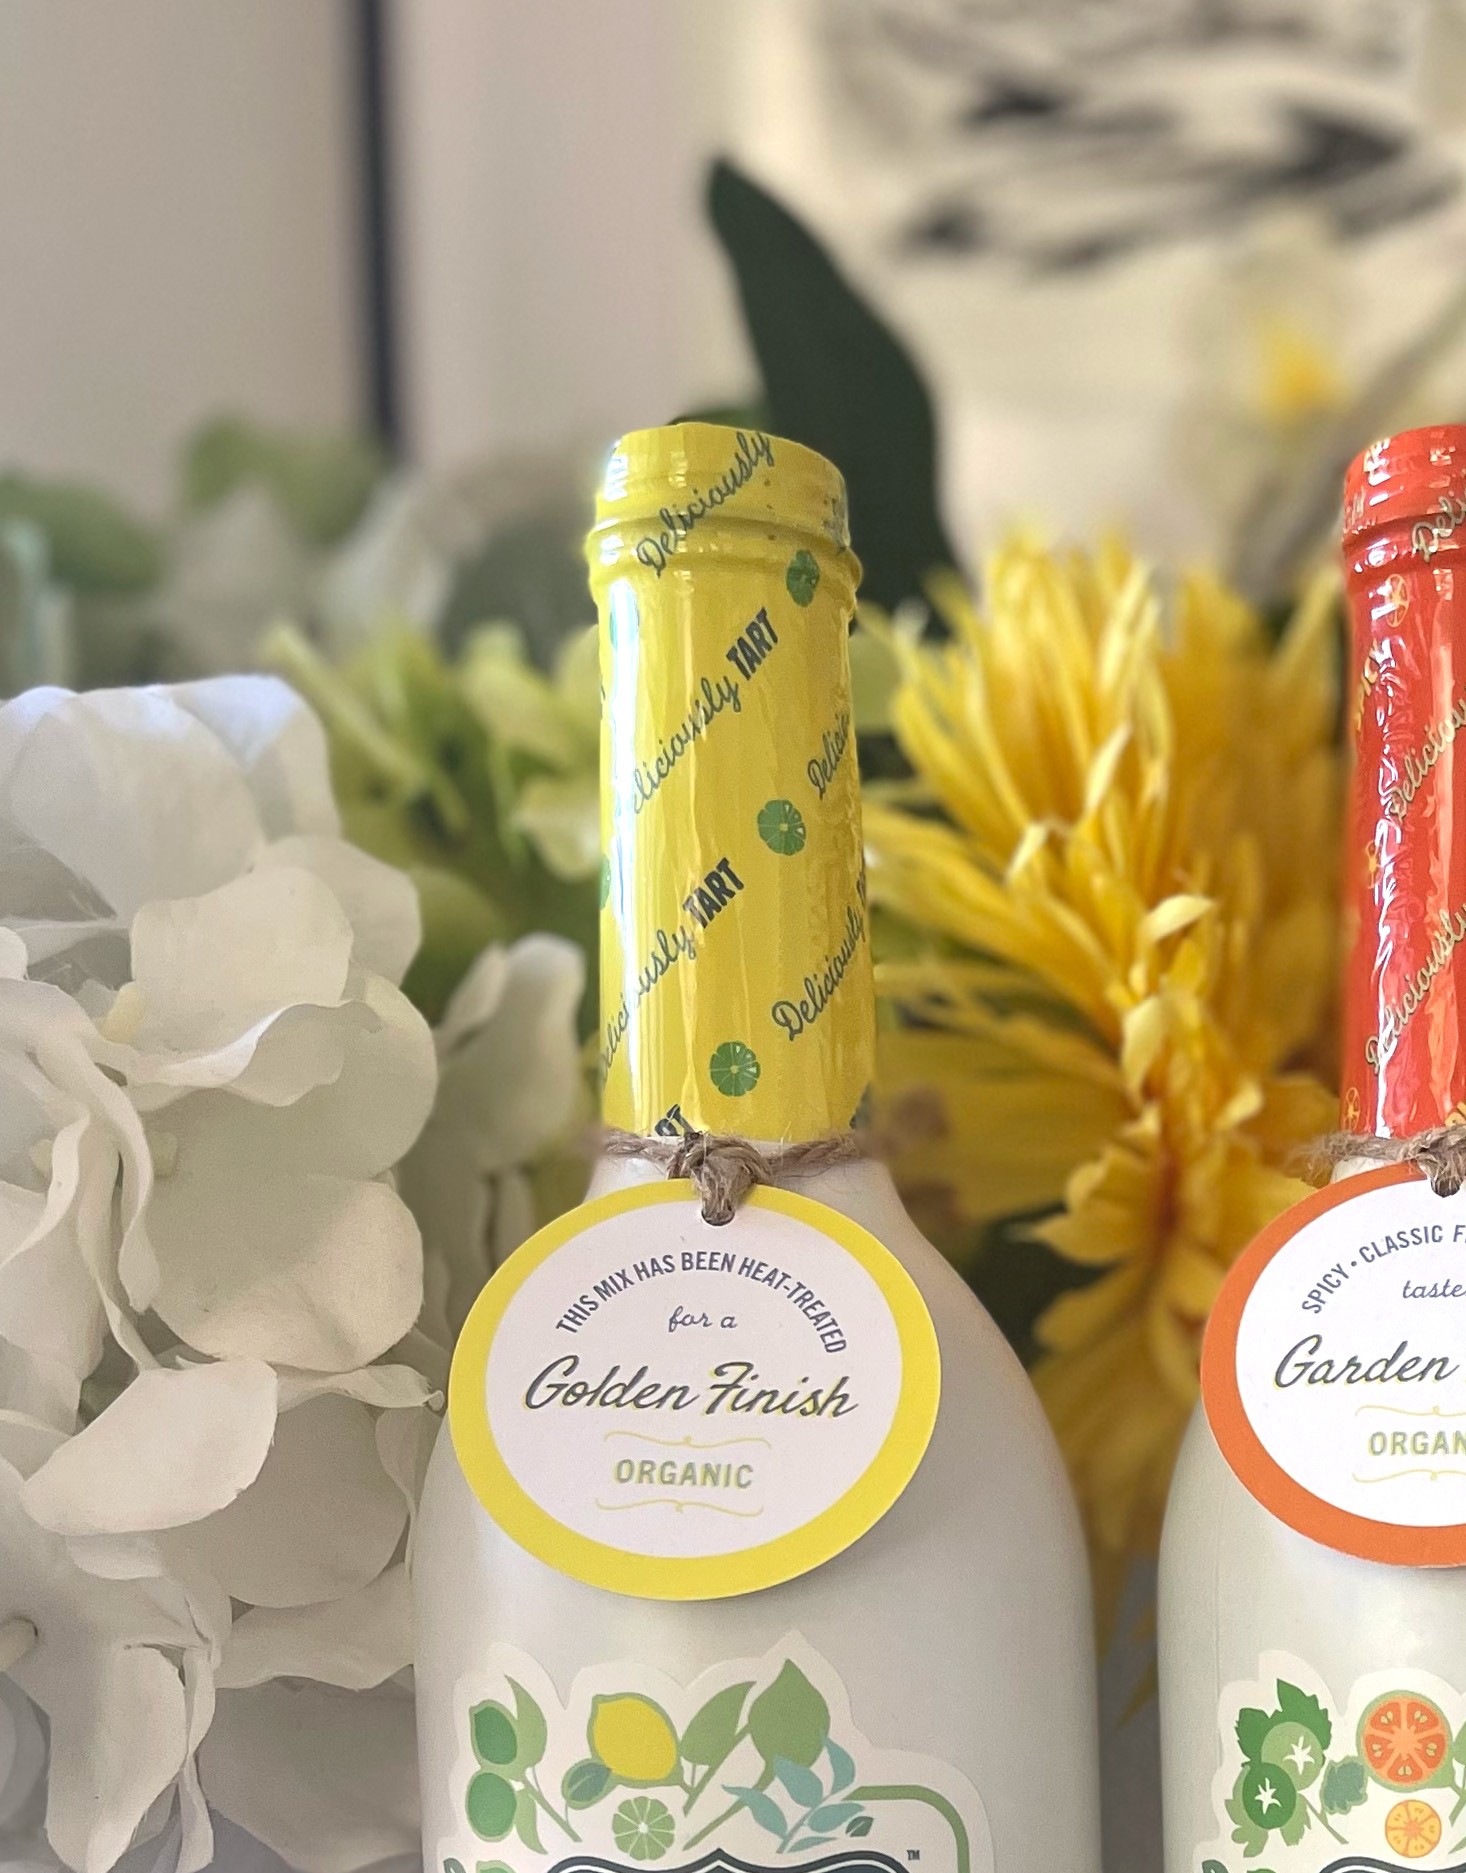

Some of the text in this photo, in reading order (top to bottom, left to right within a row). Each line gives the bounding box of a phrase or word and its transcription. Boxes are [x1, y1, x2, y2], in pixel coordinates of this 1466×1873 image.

[635, 431, 775, 579] Deliciously
[632, 606, 780, 815] liciously TART
[682, 856, 745, 929] TART
[556, 1250, 849, 1355] THIS MIX HAS BEEN HEAT-TREATED
[1301, 1261, 1351, 1315] SPICY
[1358, 1224, 1445, 1265] CLASSIC
[667, 1305, 739, 1334] for a
[523, 1354, 860, 1419] Golden Finish
[1272, 1333, 1461, 1390] Garden
[613, 1457, 755, 1490] ORGANIC
